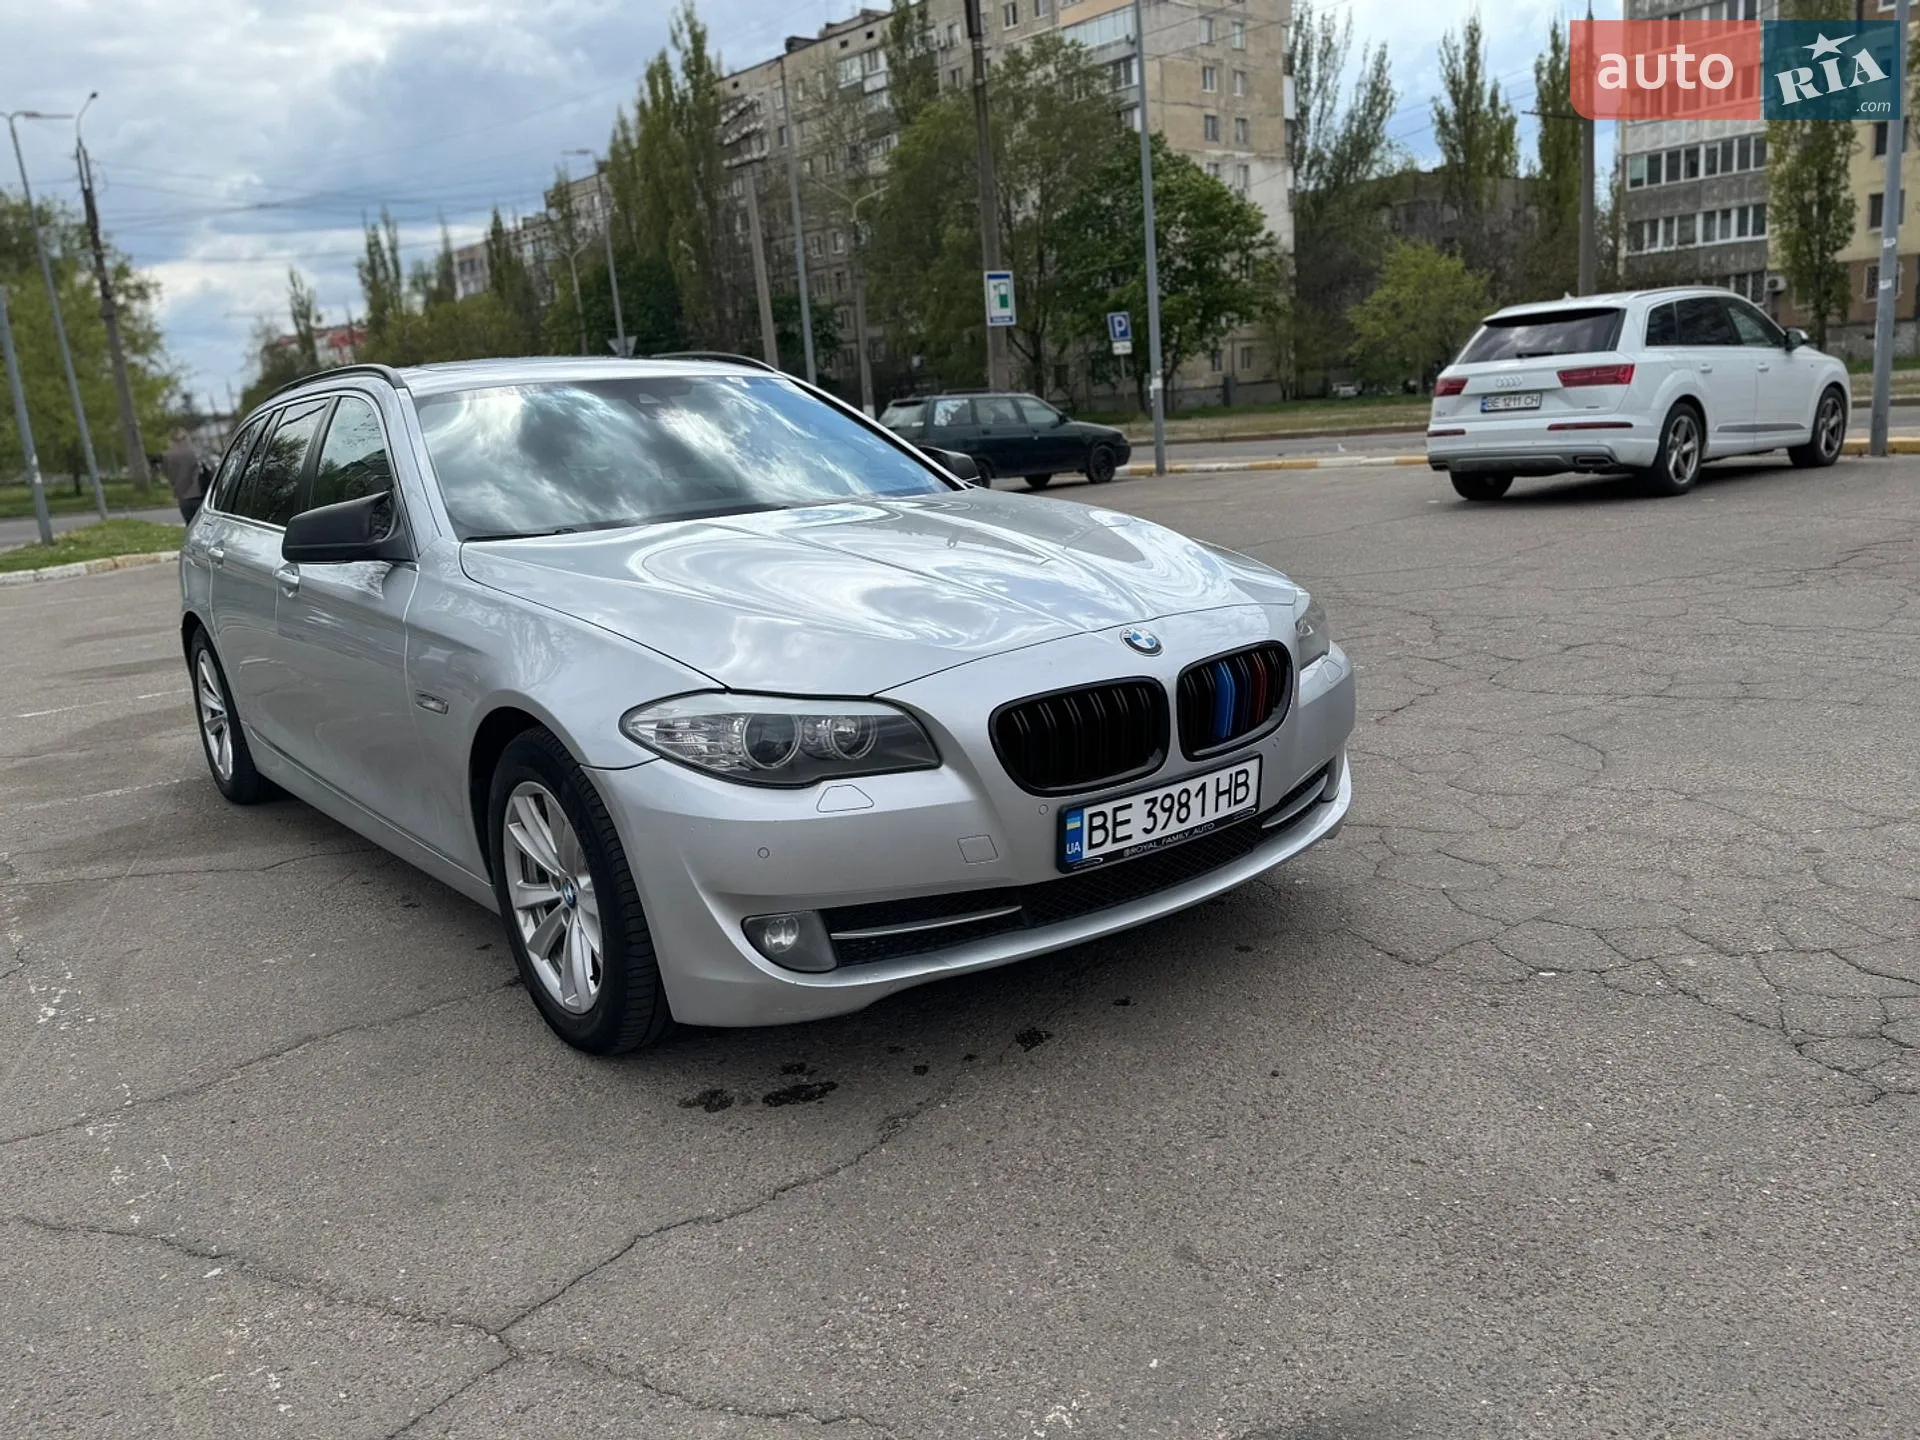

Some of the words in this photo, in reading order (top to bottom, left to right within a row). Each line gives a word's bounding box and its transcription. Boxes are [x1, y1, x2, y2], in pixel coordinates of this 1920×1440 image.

[1114, 315, 1127, 338] P
[1087, 803, 1133, 850] BE
[1142, 781, 1207, 835] 3981
[1214, 768, 1250, 812] HB
[1192, 822, 1215, 835] AUTO
[1066, 841, 1081, 854] UA
